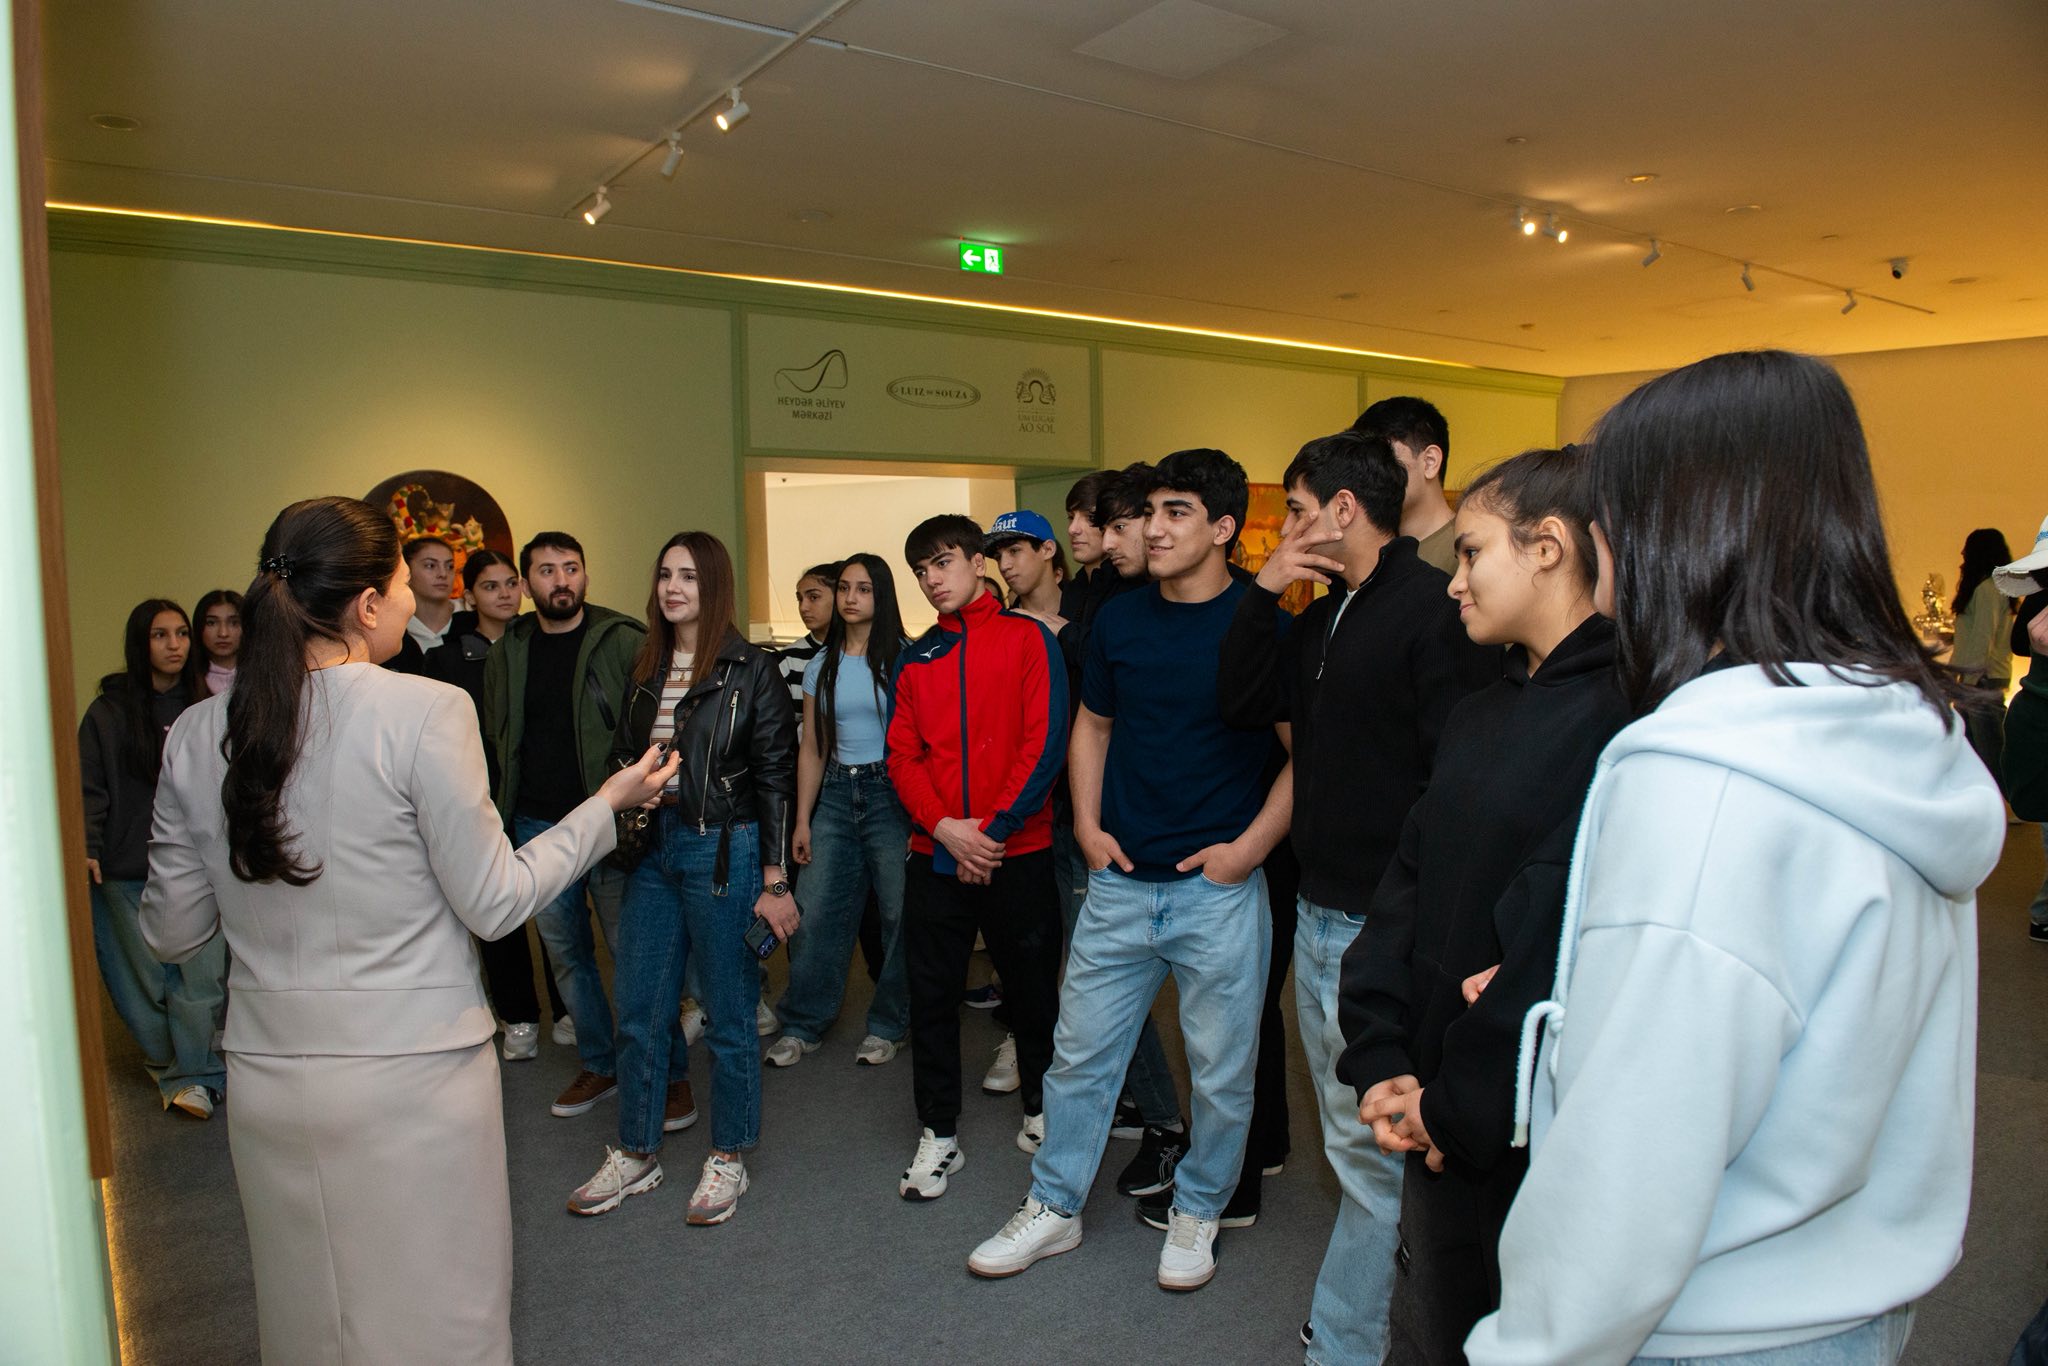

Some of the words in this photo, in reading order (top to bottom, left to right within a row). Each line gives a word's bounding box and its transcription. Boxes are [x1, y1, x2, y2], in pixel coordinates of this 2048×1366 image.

[900, 386, 925, 397] LUIZ
[935, 389, 968, 400] SOUZA
[777, 396, 813, 408] HEYDƏR
[815, 397, 846, 409] ƏLİYEV
[1018, 422, 1034, 433] AO
[1036, 422, 1056, 434] SOL
